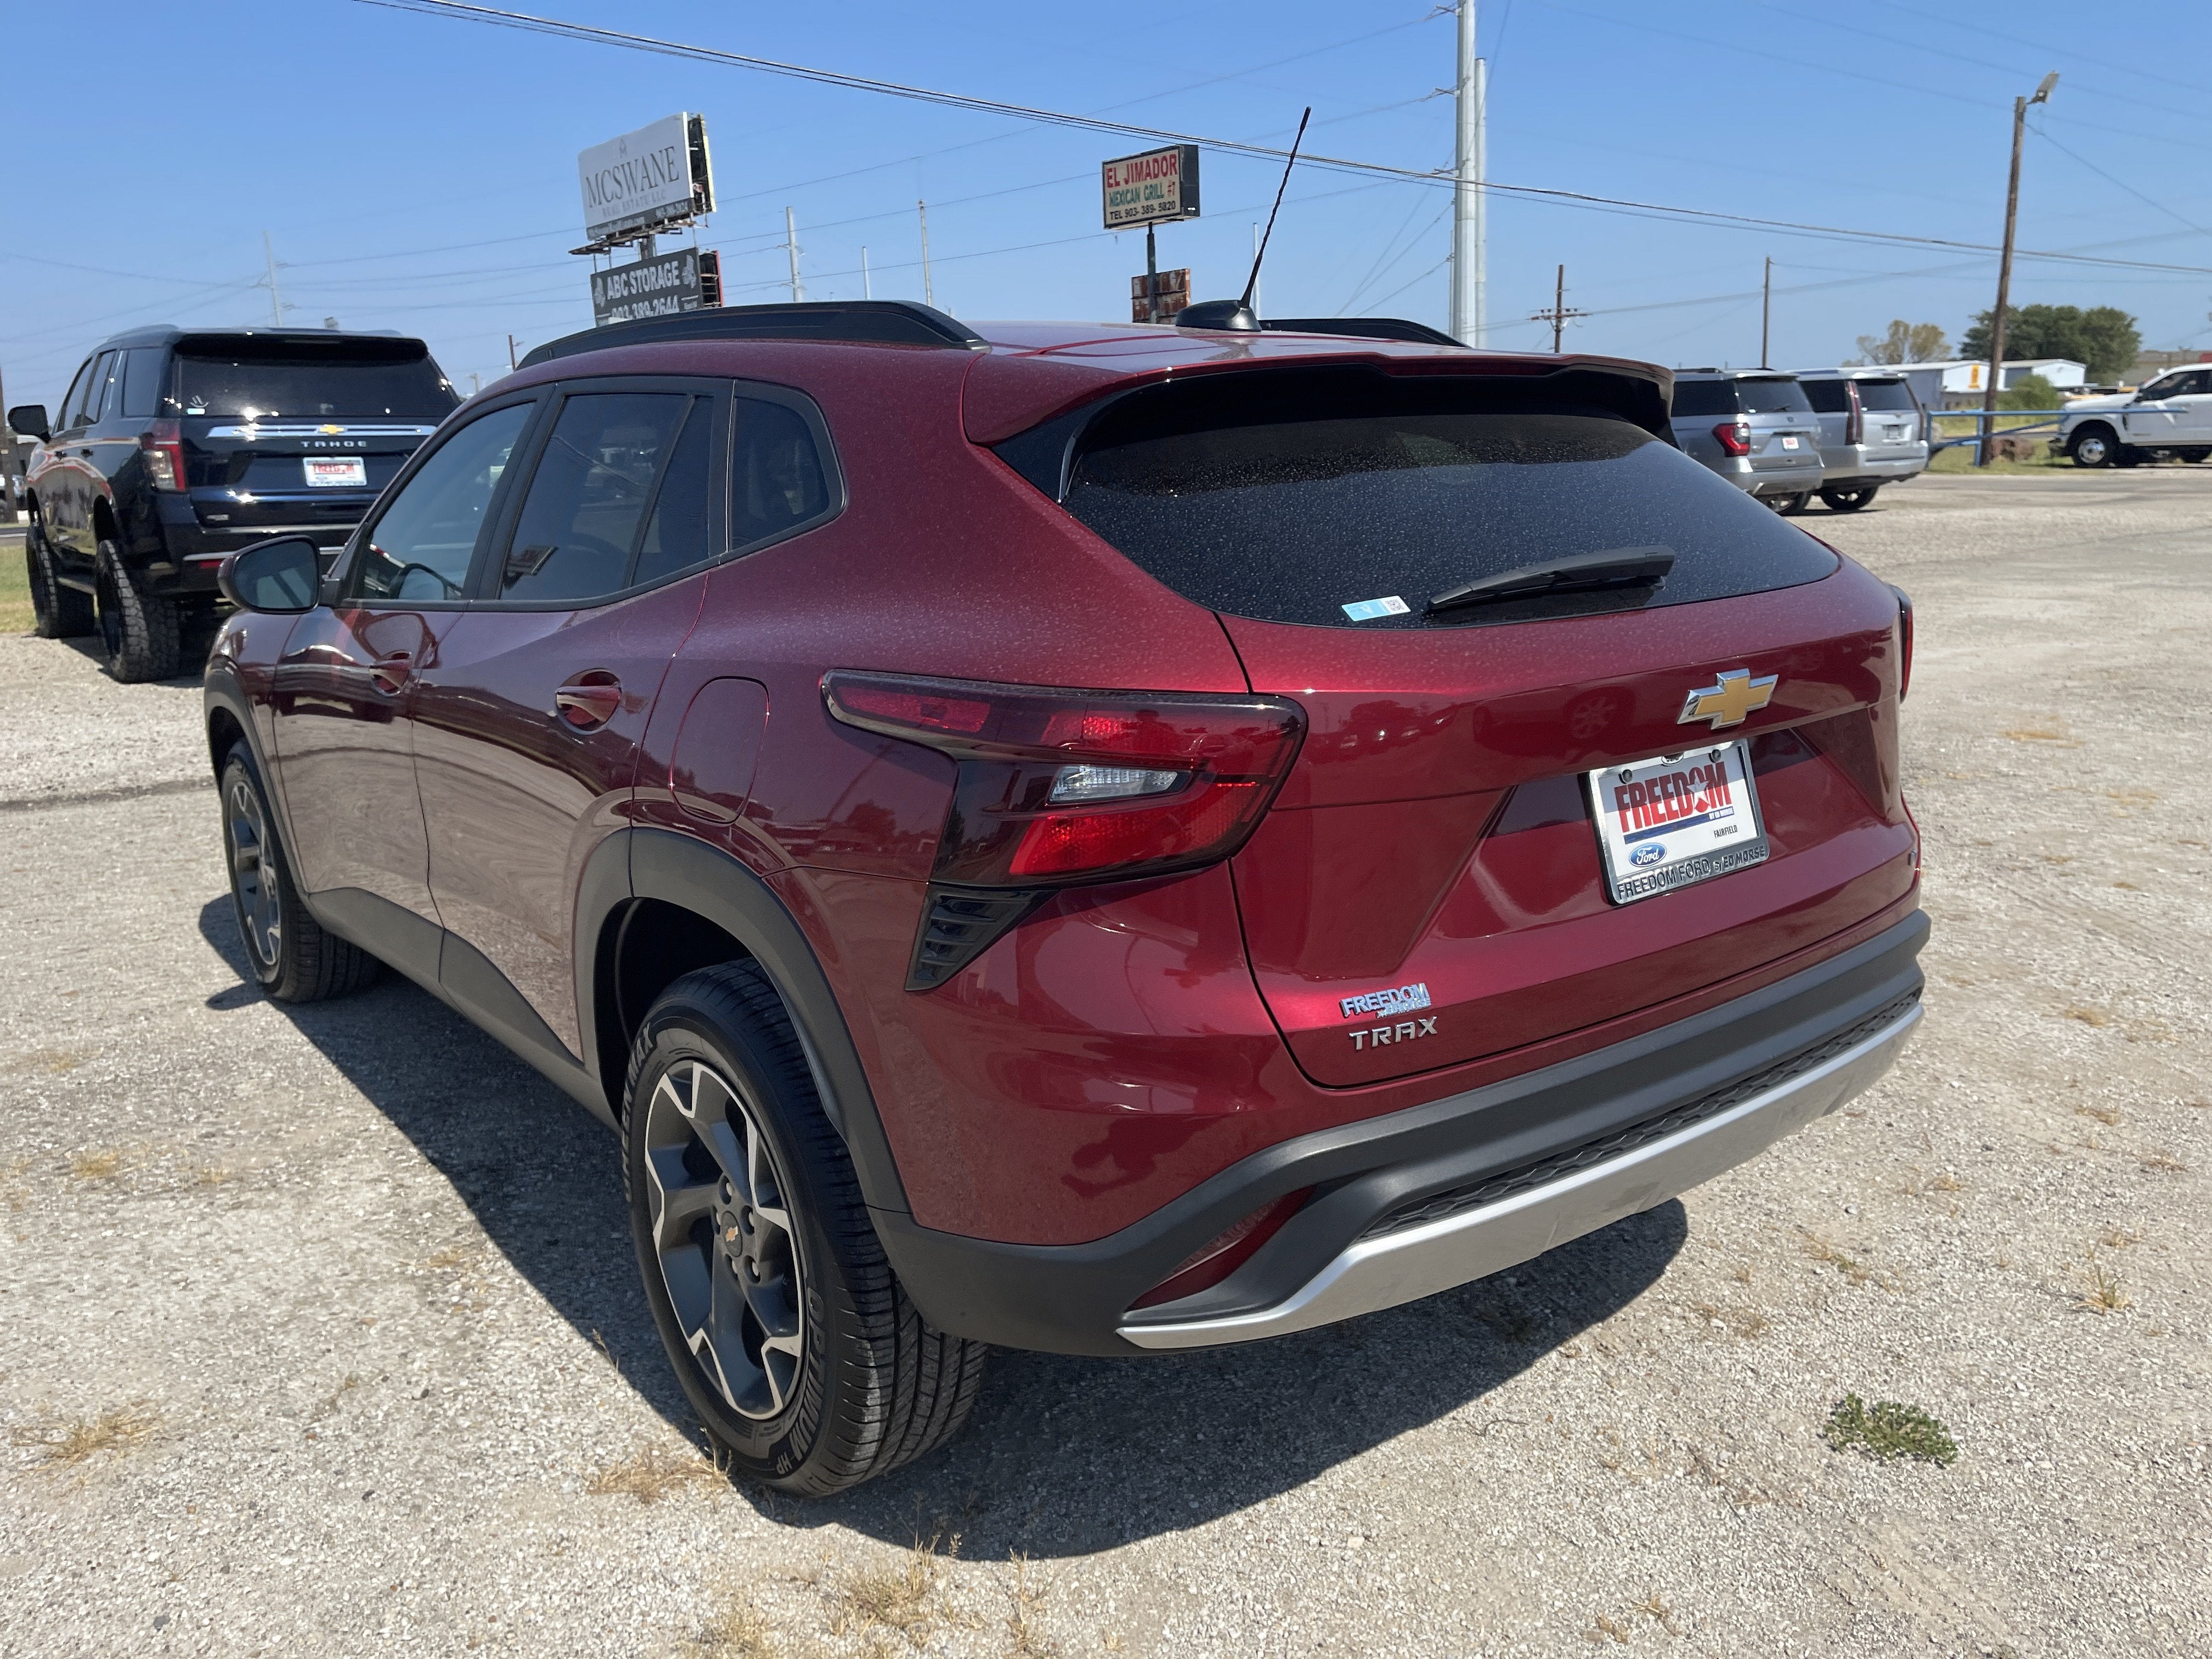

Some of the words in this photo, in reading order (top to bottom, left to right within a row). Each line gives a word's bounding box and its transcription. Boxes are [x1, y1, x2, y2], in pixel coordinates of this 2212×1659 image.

[585, 146, 680, 208] MCSWANE
[1107, 167, 1120, 188] EL
[1124, 154, 1177, 185] JIMADOR
[1109, 187, 1141, 207] MEXICAN
[1144, 182, 1164, 201] GRILL
[1110, 211, 1122, 220] TEL
[607, 273, 629, 300] ABC
[630, 261, 681, 295] STORAGE
[1614, 761, 1732, 833] FREEDOM
[1713, 825, 1737, 838] FAIRFIELD
[1636, 847, 1660, 863] Ford
[1617, 867, 1677, 900] FREEDOM
[1679, 859, 1711, 882] FORD
[1340, 983, 1431, 1018] FREEDOM
[1349, 1016, 1438, 1050] TRAX
